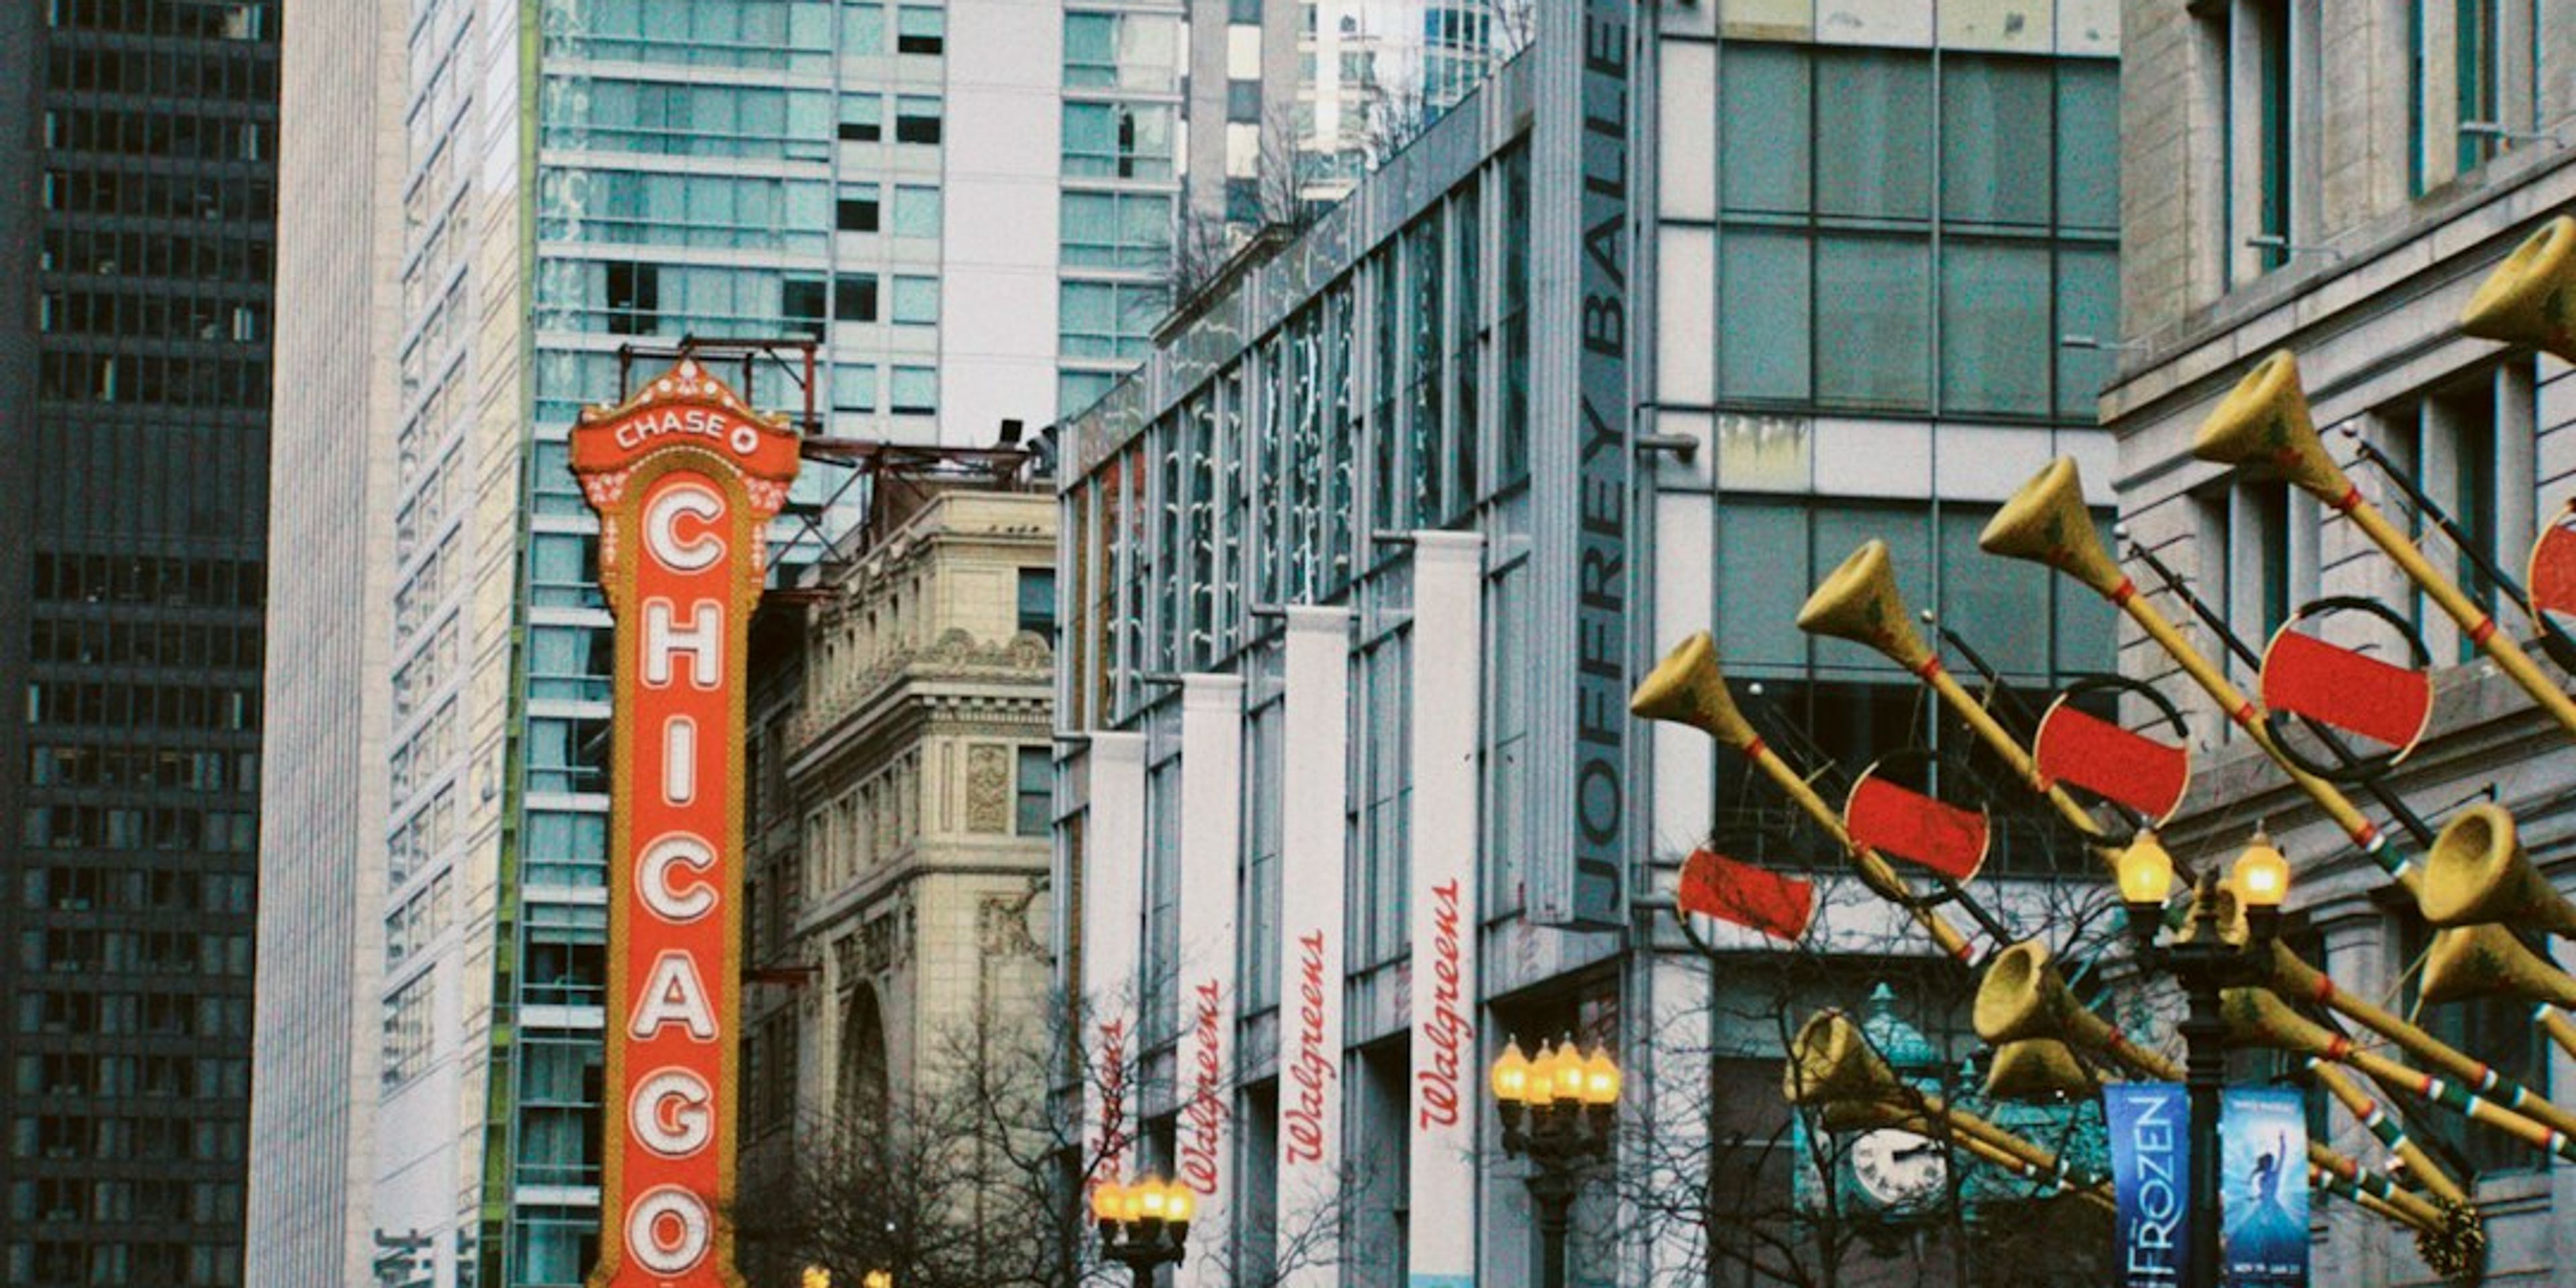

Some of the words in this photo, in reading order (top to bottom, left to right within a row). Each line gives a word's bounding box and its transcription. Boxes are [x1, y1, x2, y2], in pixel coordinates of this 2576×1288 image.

[1583, 0, 1628, 360] BALLE
[614, 409, 727, 449] CHASE
[1575, 394, 1626, 914] JOFFREY
[625, 481, 727, 1278] CHICAGO
[1180, 979, 1231, 1195] Walgreens
[1283, 929, 1337, 1165] Walgreens
[1417, 879, 1473, 1132] Walgreens
[2128, 1095, 2185, 1275] FROZEN
